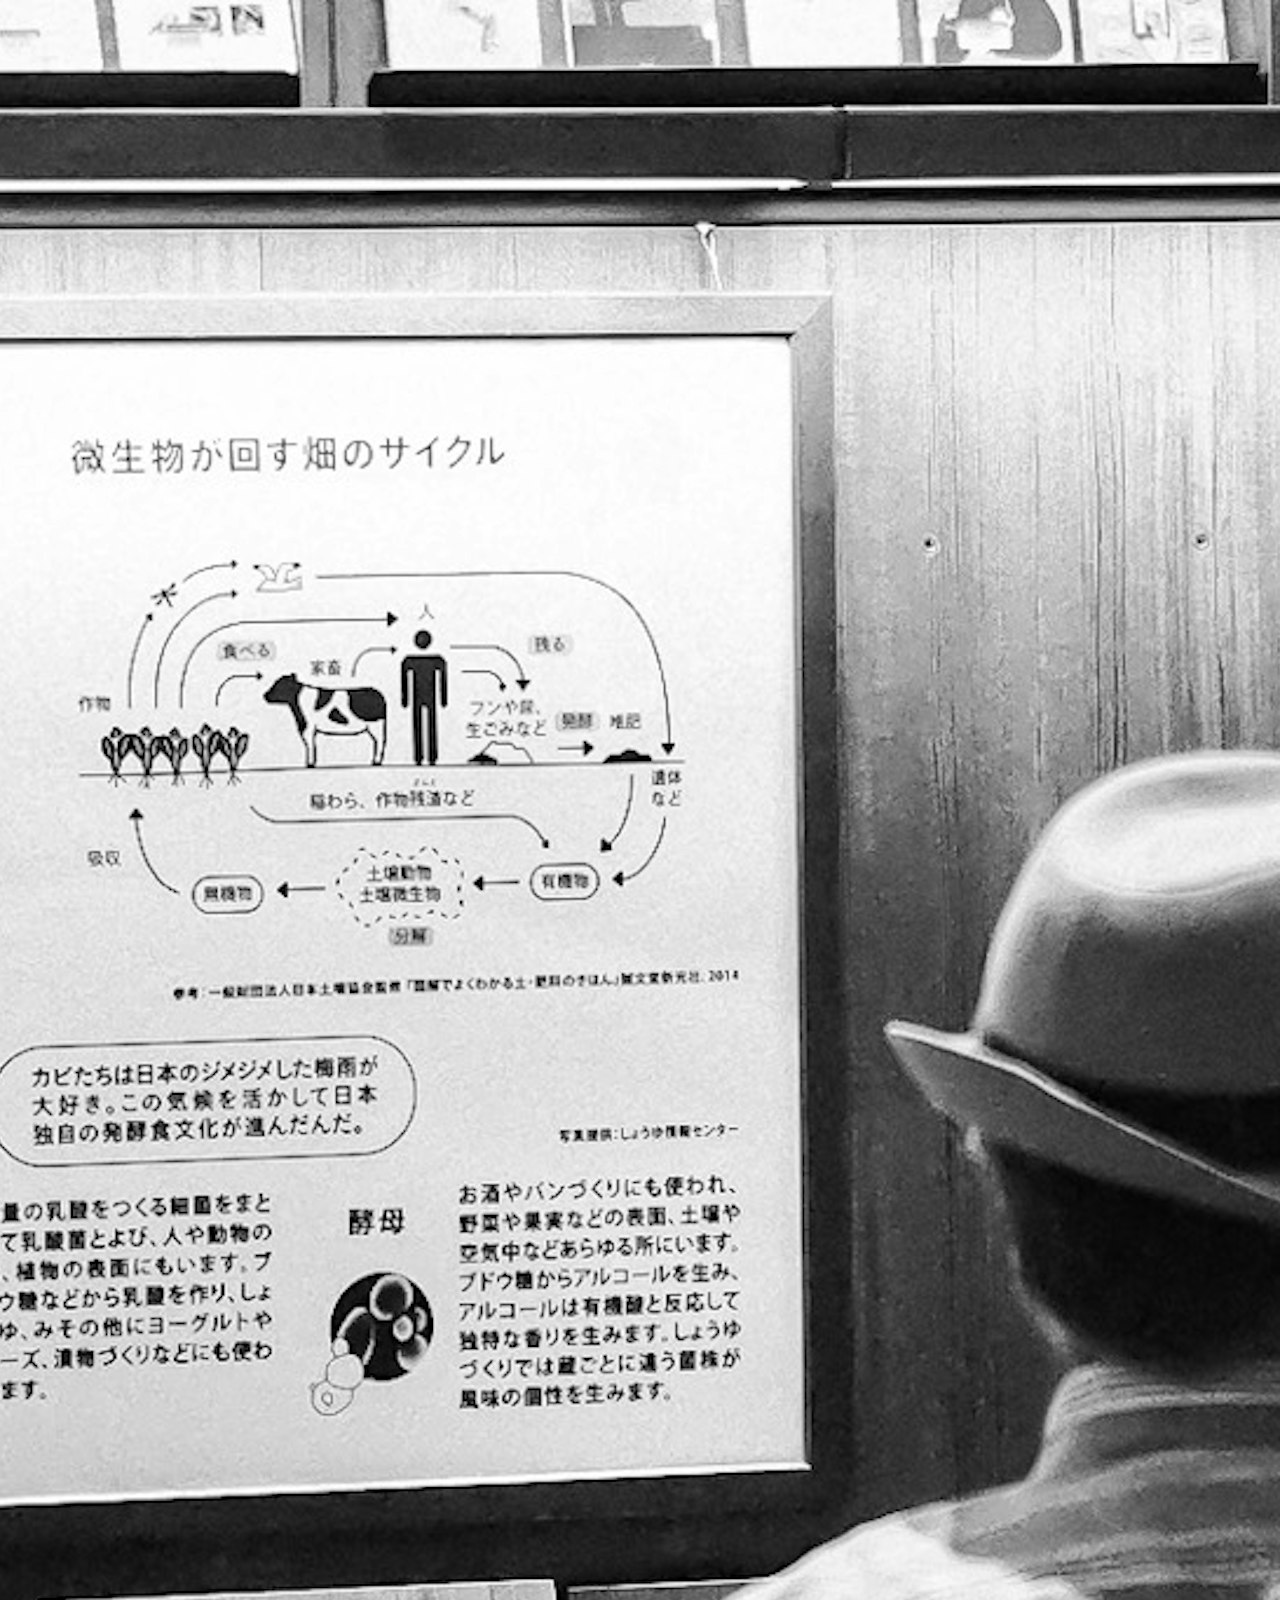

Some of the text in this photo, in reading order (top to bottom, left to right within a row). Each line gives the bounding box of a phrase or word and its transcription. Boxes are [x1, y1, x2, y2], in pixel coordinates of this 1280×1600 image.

[71, 435, 505, 476] 微生物が回す畑のサイクル
[419, 604, 435, 620] 人
[223, 643, 270, 659] 食べる
[466, 719, 547, 739] 生ごみなど
[651, 790, 682, 807] など
[541, 872, 590, 889] 有機物
[31, 1056, 378, 1088] カビたちは日本のジメジメした梅雨が
[31, 1084, 378, 1116] 大好き。この気候を活かして日本
[32, 1112, 363, 1146] 独自の発酵食文化が進んだんだ。
[348, 1207, 407, 1237] 酵母
[459, 1204, 740, 1233] 野菜や果実などの表面、土壌や
[459, 1232, 739, 1263] 空気中などあらゆる所にいます。
[459, 1262, 739, 1291] ブドウ糖からアルコールを生み、
[459, 1290, 740, 1321] アルコールは有機酸と反応して
[459, 1319, 741, 1351] 独特な香りを生みます。しょうゆ
[459, 1380, 671, 1409] 風味の個性を生みます。
